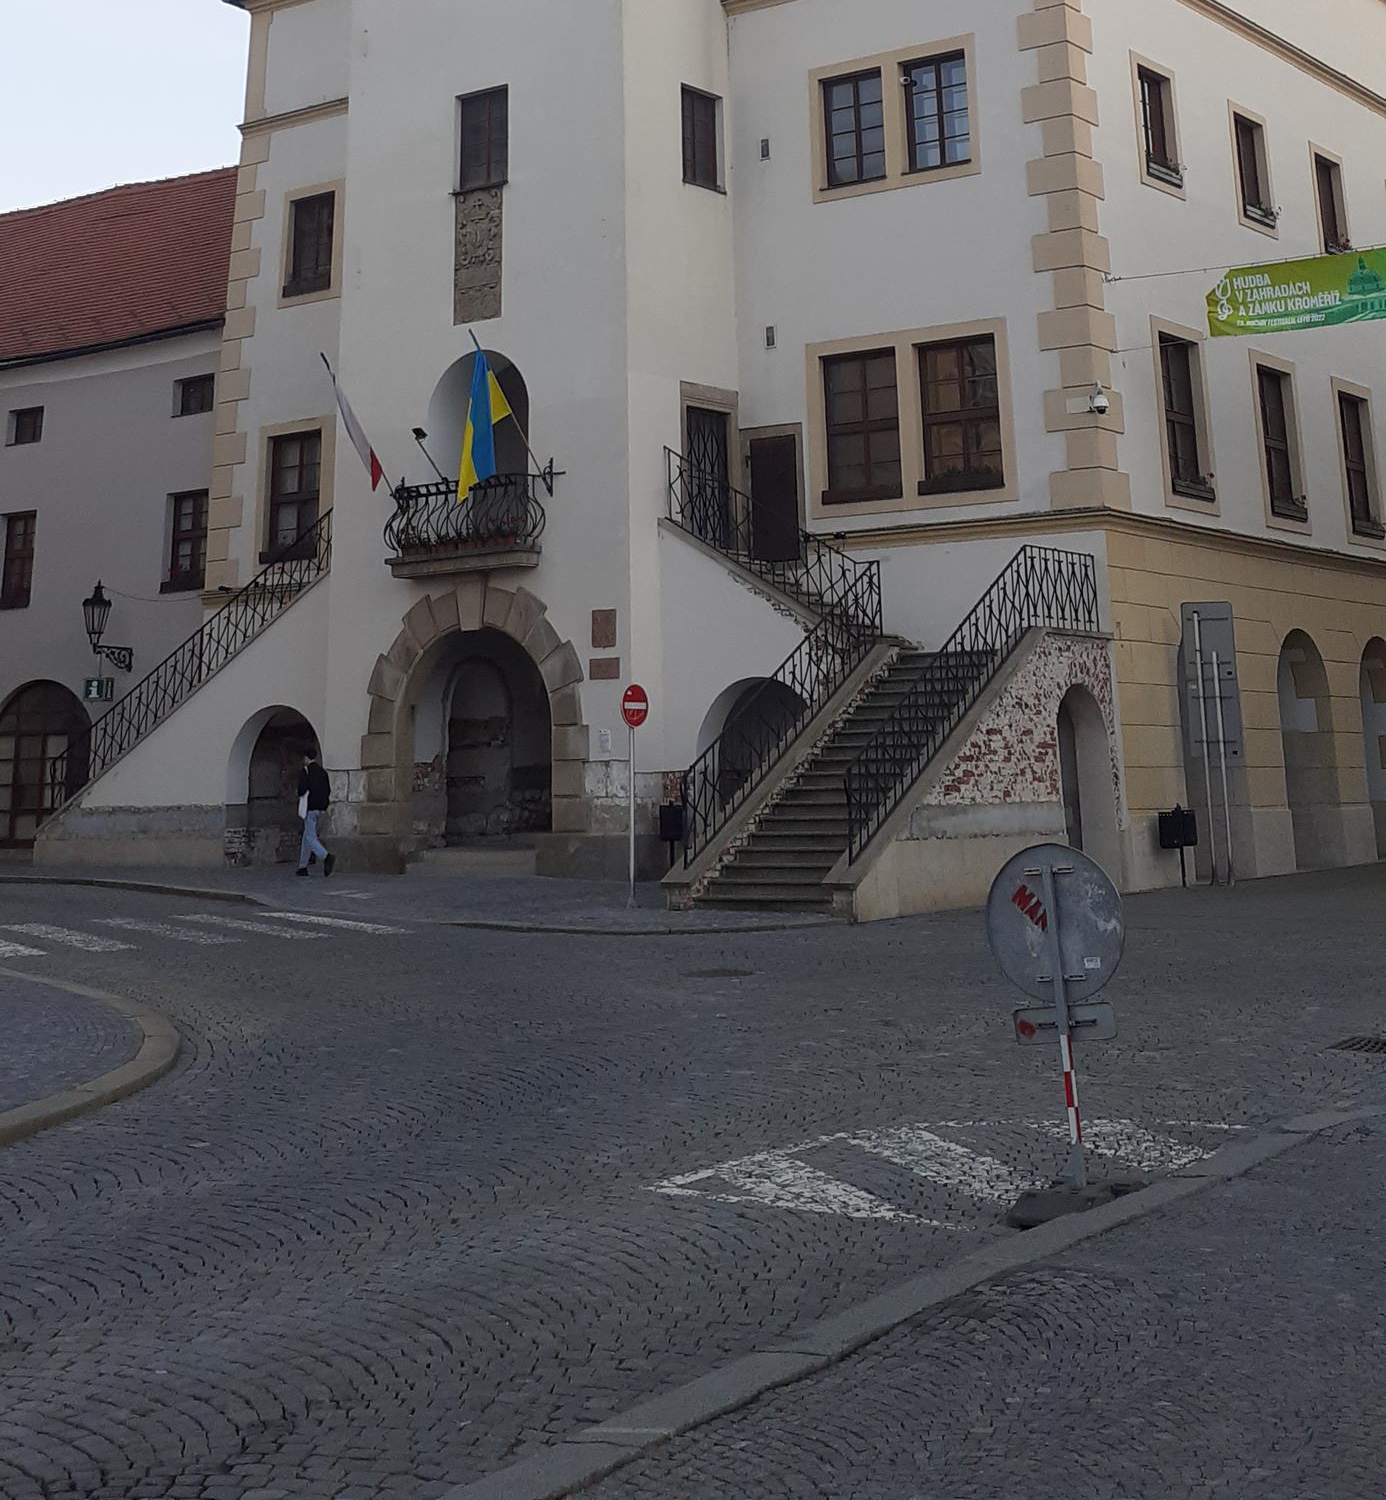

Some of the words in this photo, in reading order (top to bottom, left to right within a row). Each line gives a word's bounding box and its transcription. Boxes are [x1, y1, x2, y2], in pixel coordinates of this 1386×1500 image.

[1233, 274, 1271, 289] HUDBA
[1236, 290, 1243, 303] V
[1246, 281, 1311, 302] ZAHRADÁCH
[1239, 304, 1246, 316] A
[1248, 299, 1285, 316] ZÁMKU
